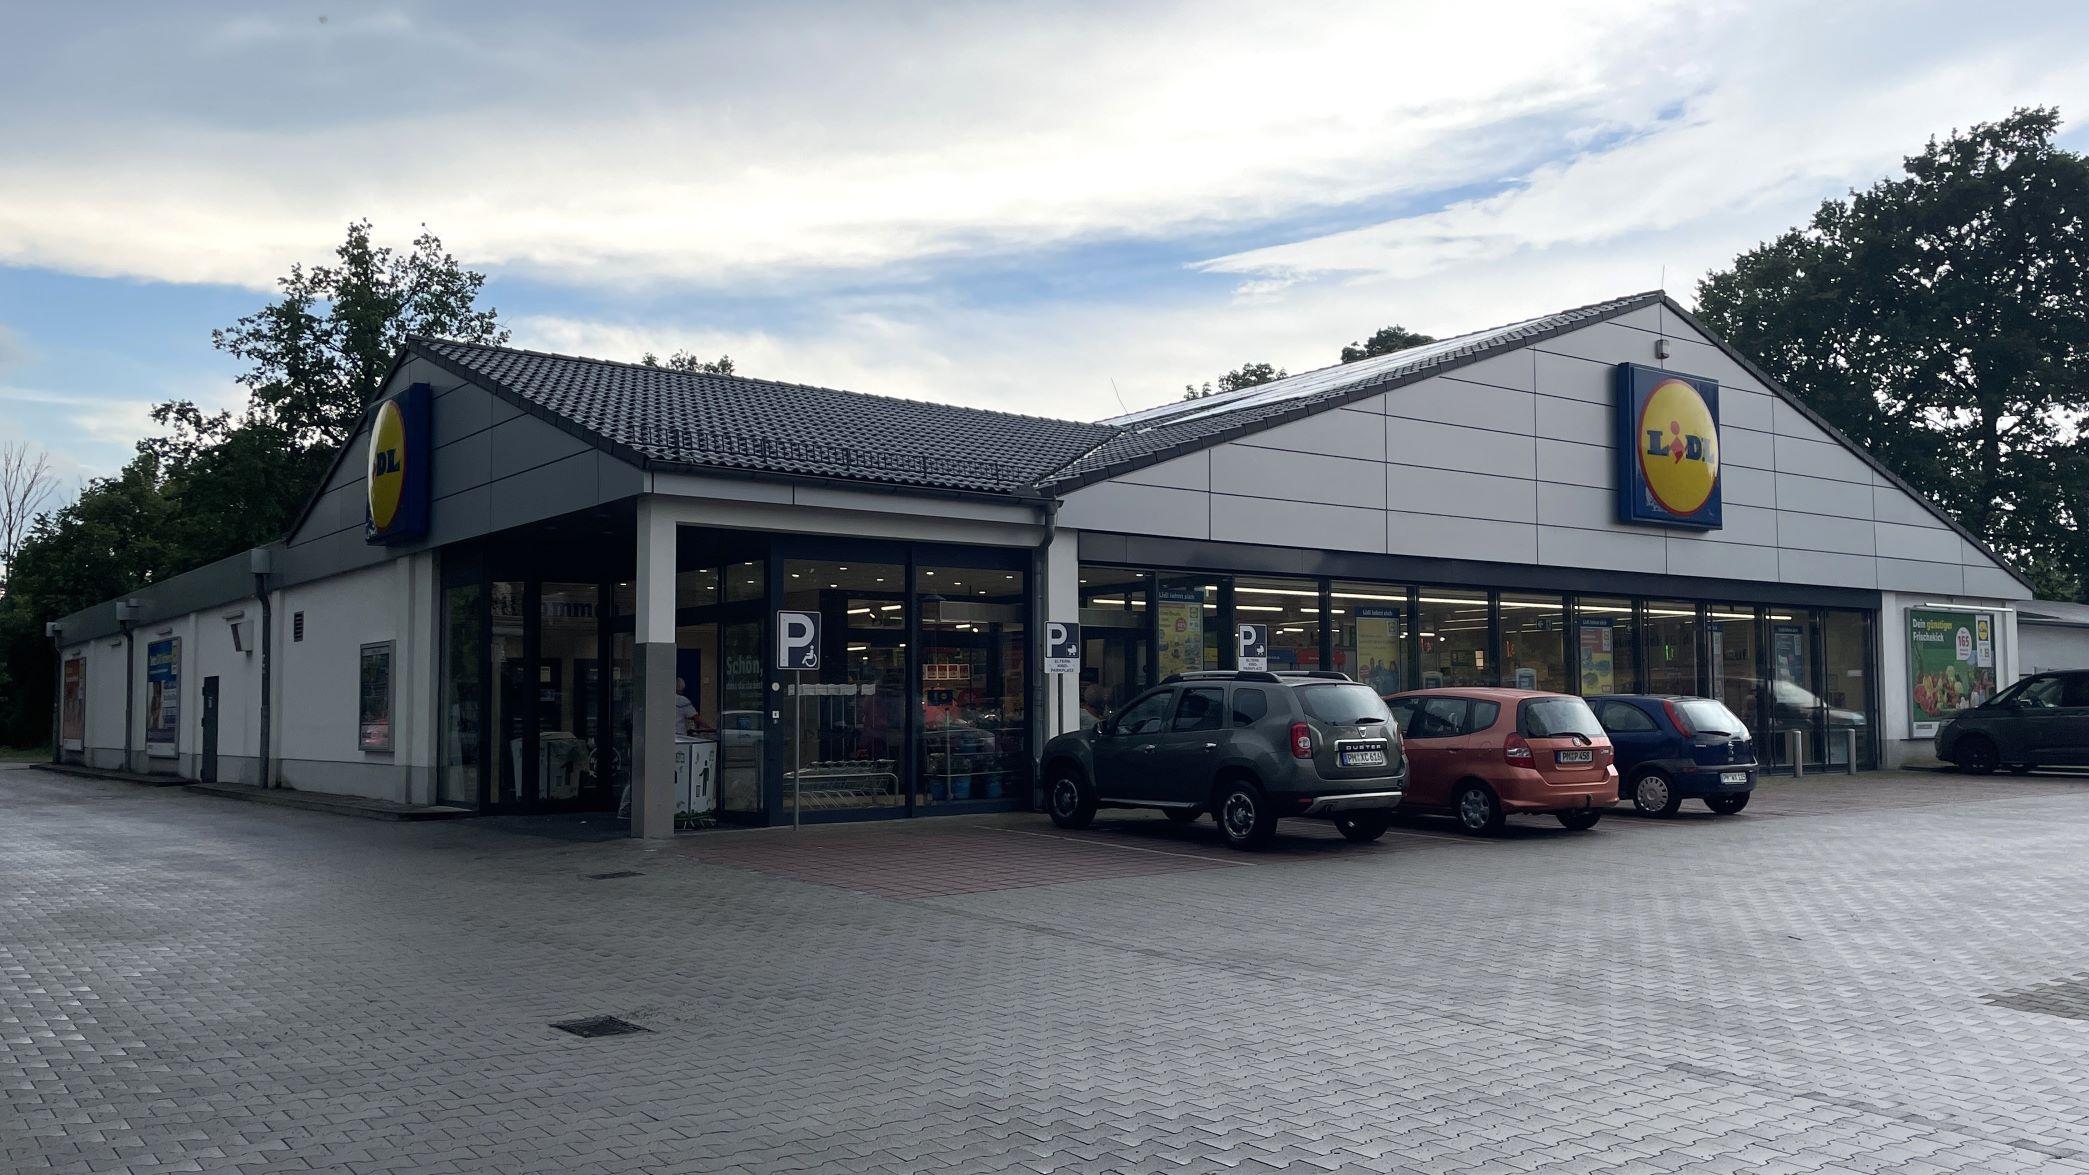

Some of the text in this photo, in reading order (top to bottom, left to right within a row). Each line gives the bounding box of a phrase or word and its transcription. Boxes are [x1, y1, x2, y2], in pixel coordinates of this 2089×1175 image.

[779, 613, 815, 668] P
[1046, 622, 1068, 658] P
[1912, 618, 1926, 629] Dein
[1239, 625, 1257, 657] P
